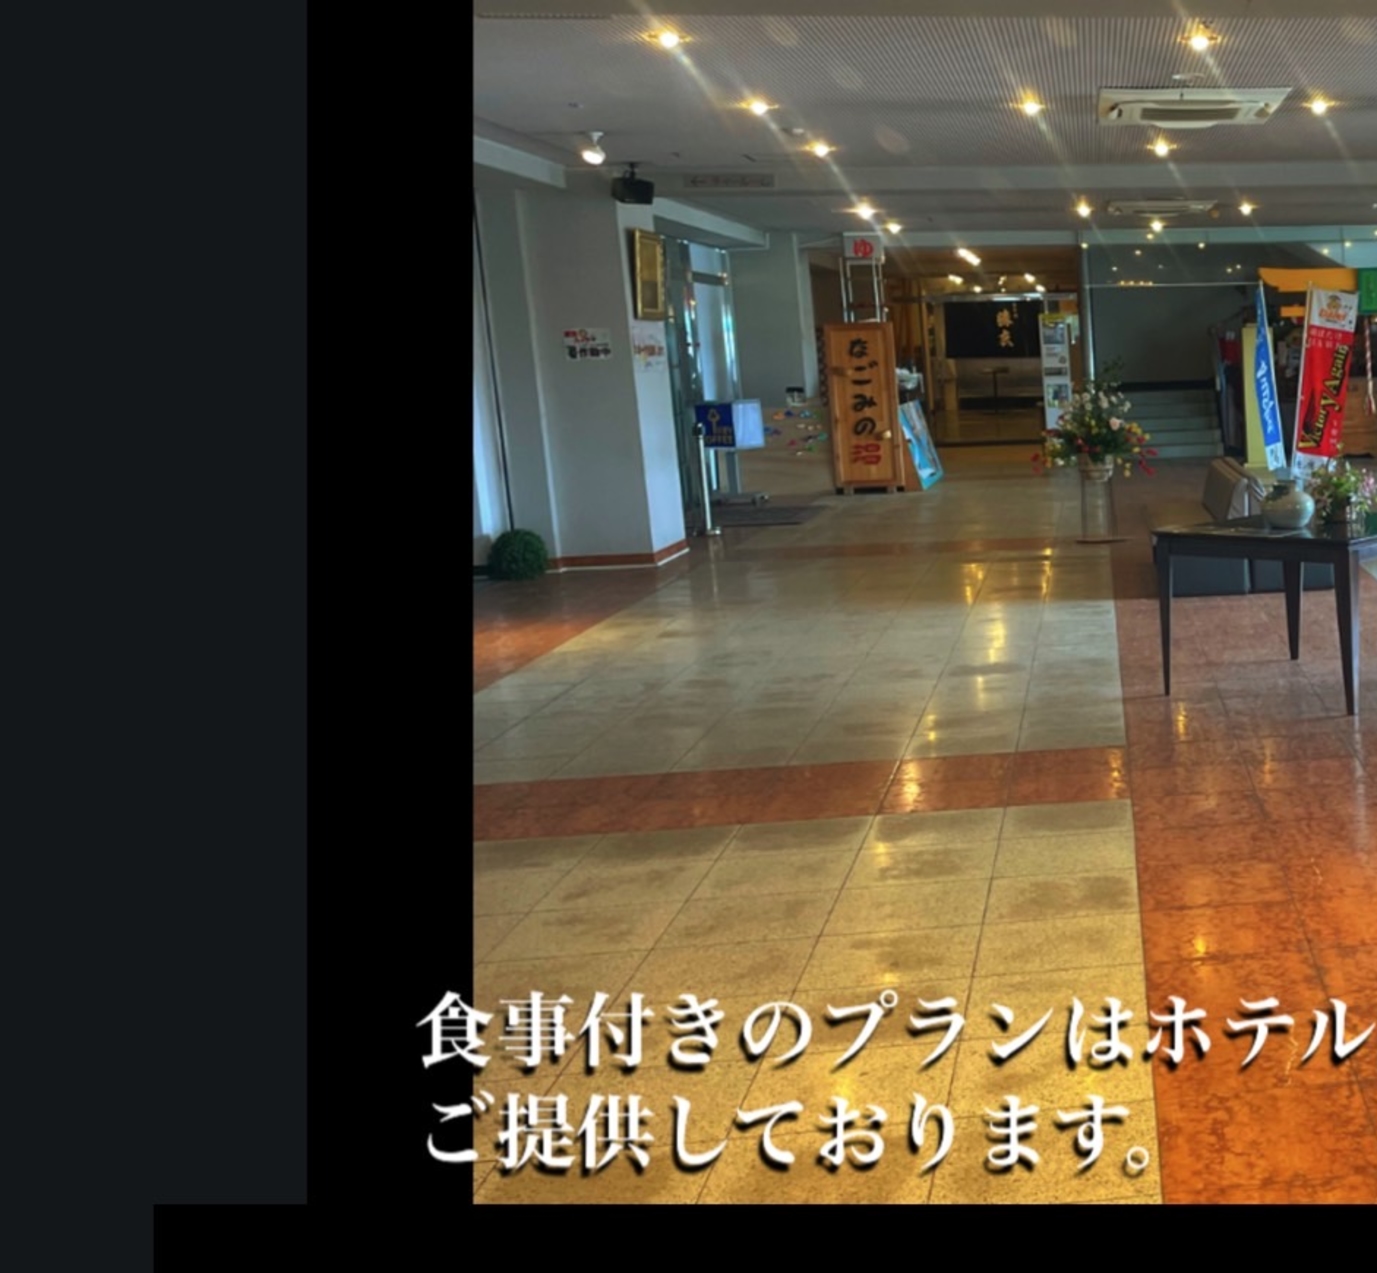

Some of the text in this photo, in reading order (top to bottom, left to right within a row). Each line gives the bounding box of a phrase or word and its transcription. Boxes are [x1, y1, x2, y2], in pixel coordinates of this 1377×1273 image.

[852, 239, 874, 257] ゆ
[848, 338, 882, 465] なごみの湯
